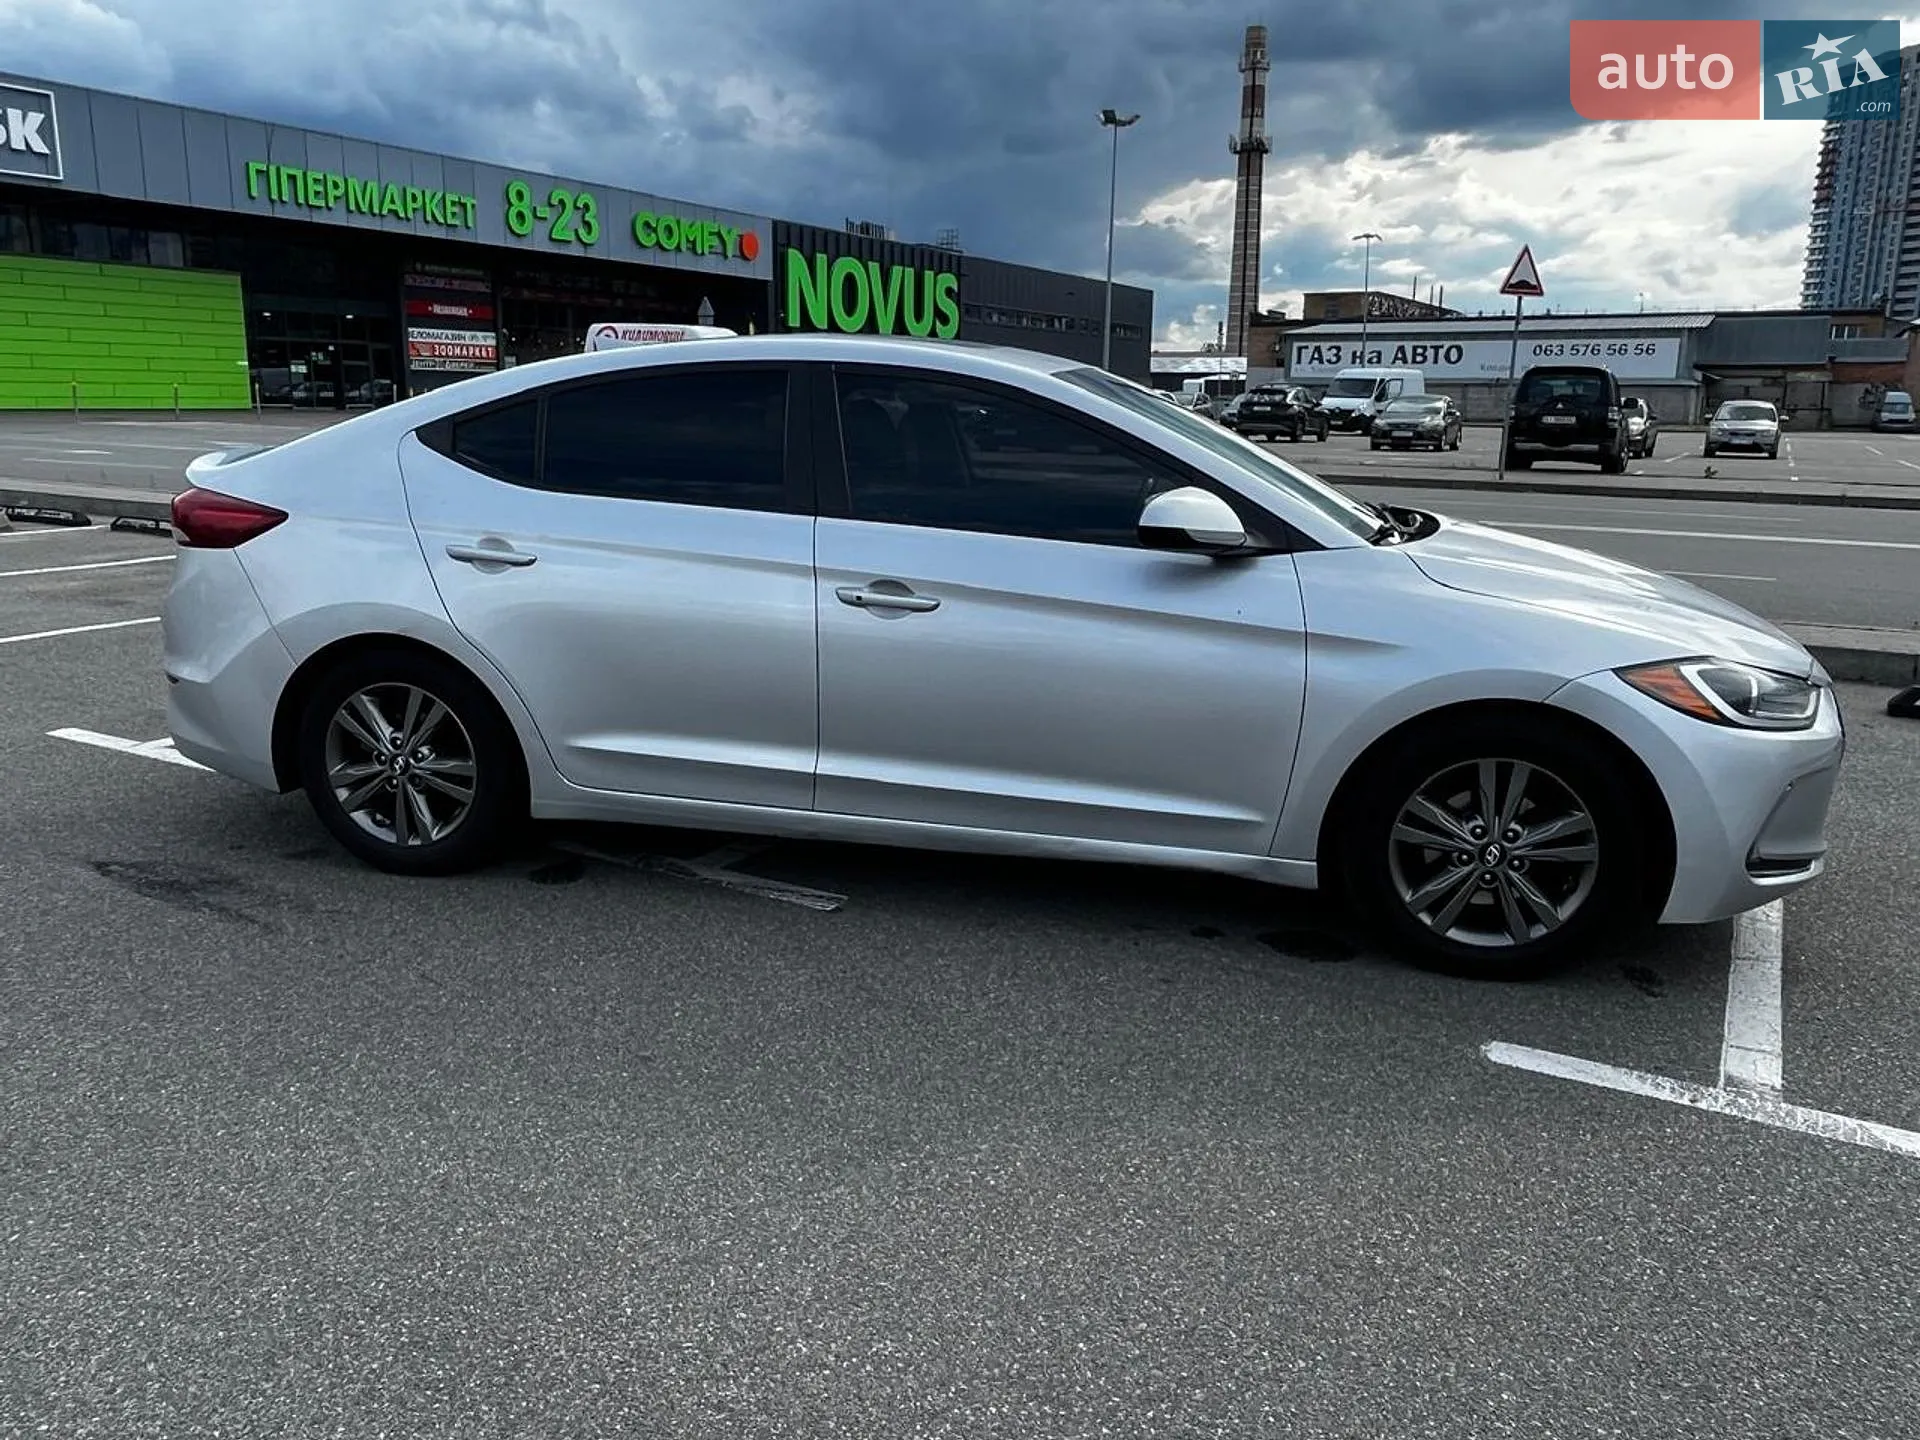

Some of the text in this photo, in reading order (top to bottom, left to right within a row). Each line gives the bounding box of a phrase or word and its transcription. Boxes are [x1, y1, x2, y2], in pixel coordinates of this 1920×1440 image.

[246, 161, 477, 229] ГІПЕРМАРКЕТ
[505, 179, 600, 246] 8-23
[633, 210, 741, 260] COMFY
[786, 247, 960, 340] NOVUS
[433, 344, 493, 358] ЗООМАРКЕТ
[1295, 344, 1464, 365] ГАЗ на АВТО
[1532, 342, 1656, 357] 063 576 56 56
